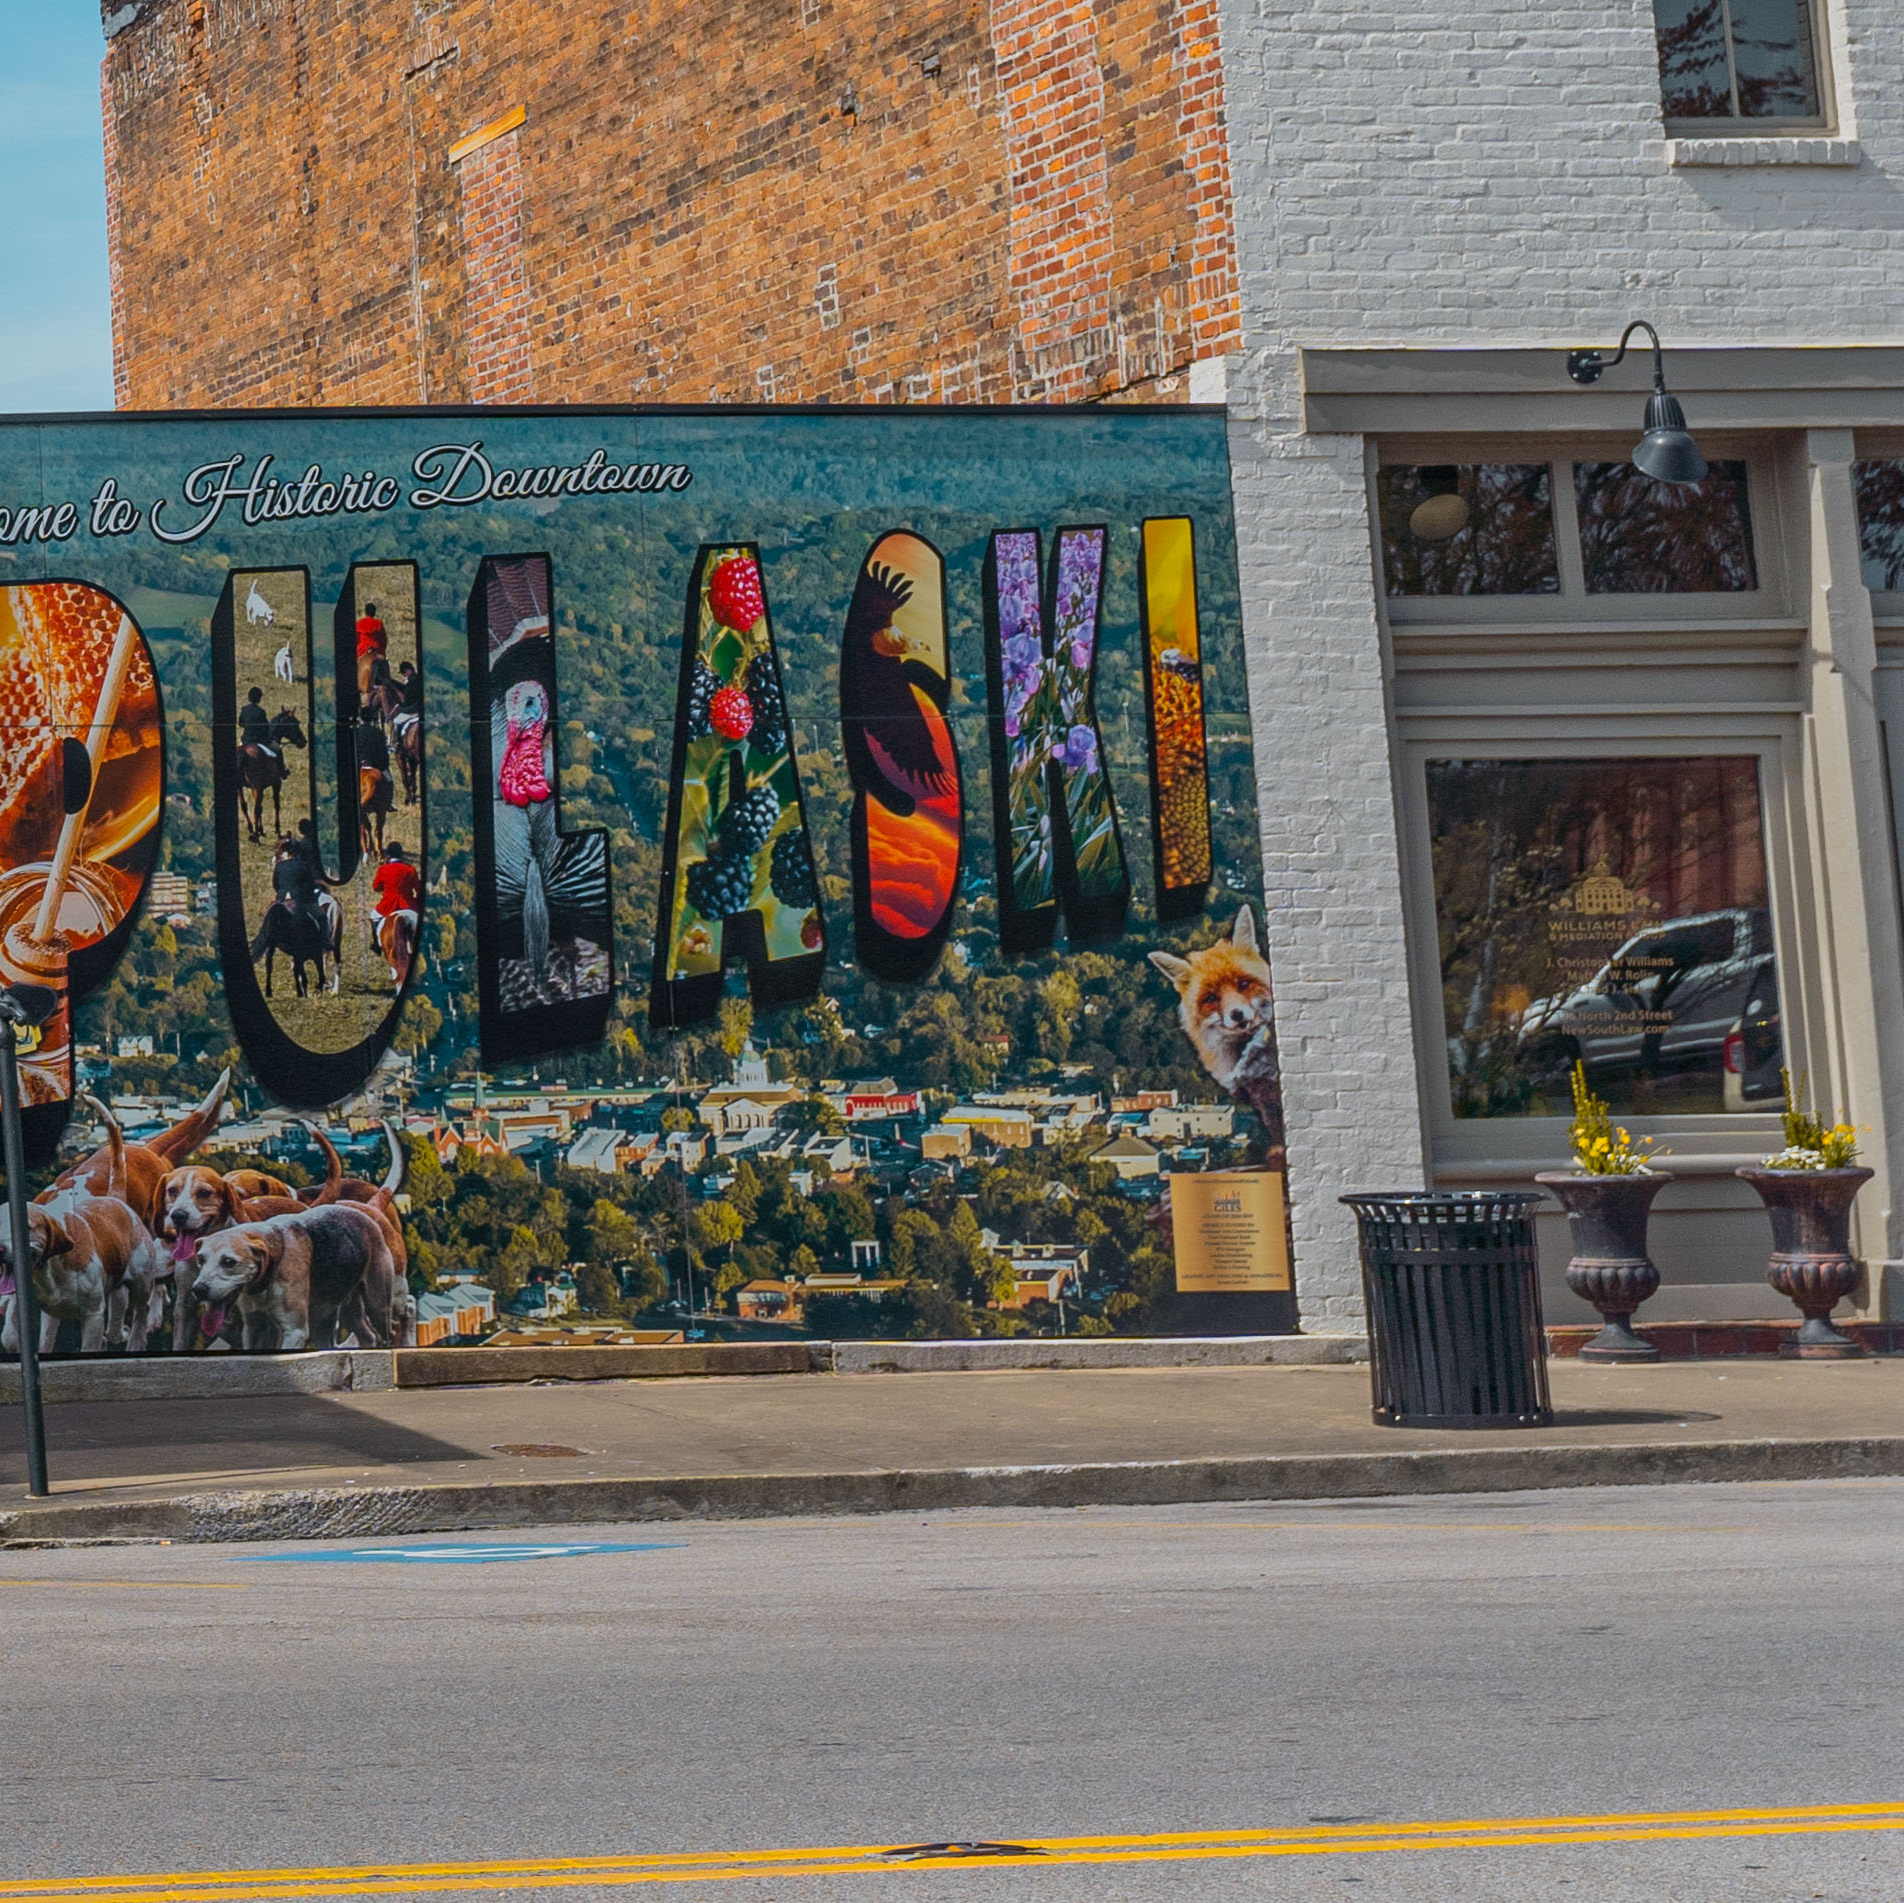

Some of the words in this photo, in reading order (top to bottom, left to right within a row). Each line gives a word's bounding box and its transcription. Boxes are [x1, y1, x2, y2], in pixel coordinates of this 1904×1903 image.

[90, 477, 140, 538] to
[149, 451, 399, 546] Historic
[409, 440, 693, 510] Downtown
[1547, 920, 1626, 932] WILLIAMS
[1559, 931, 1623, 941] MEDIATION
[1625, 956, 1674, 968] Williams
[1614, 1009, 1636, 1021] 2nd
[1638, 1009, 1673, 1021] Street
